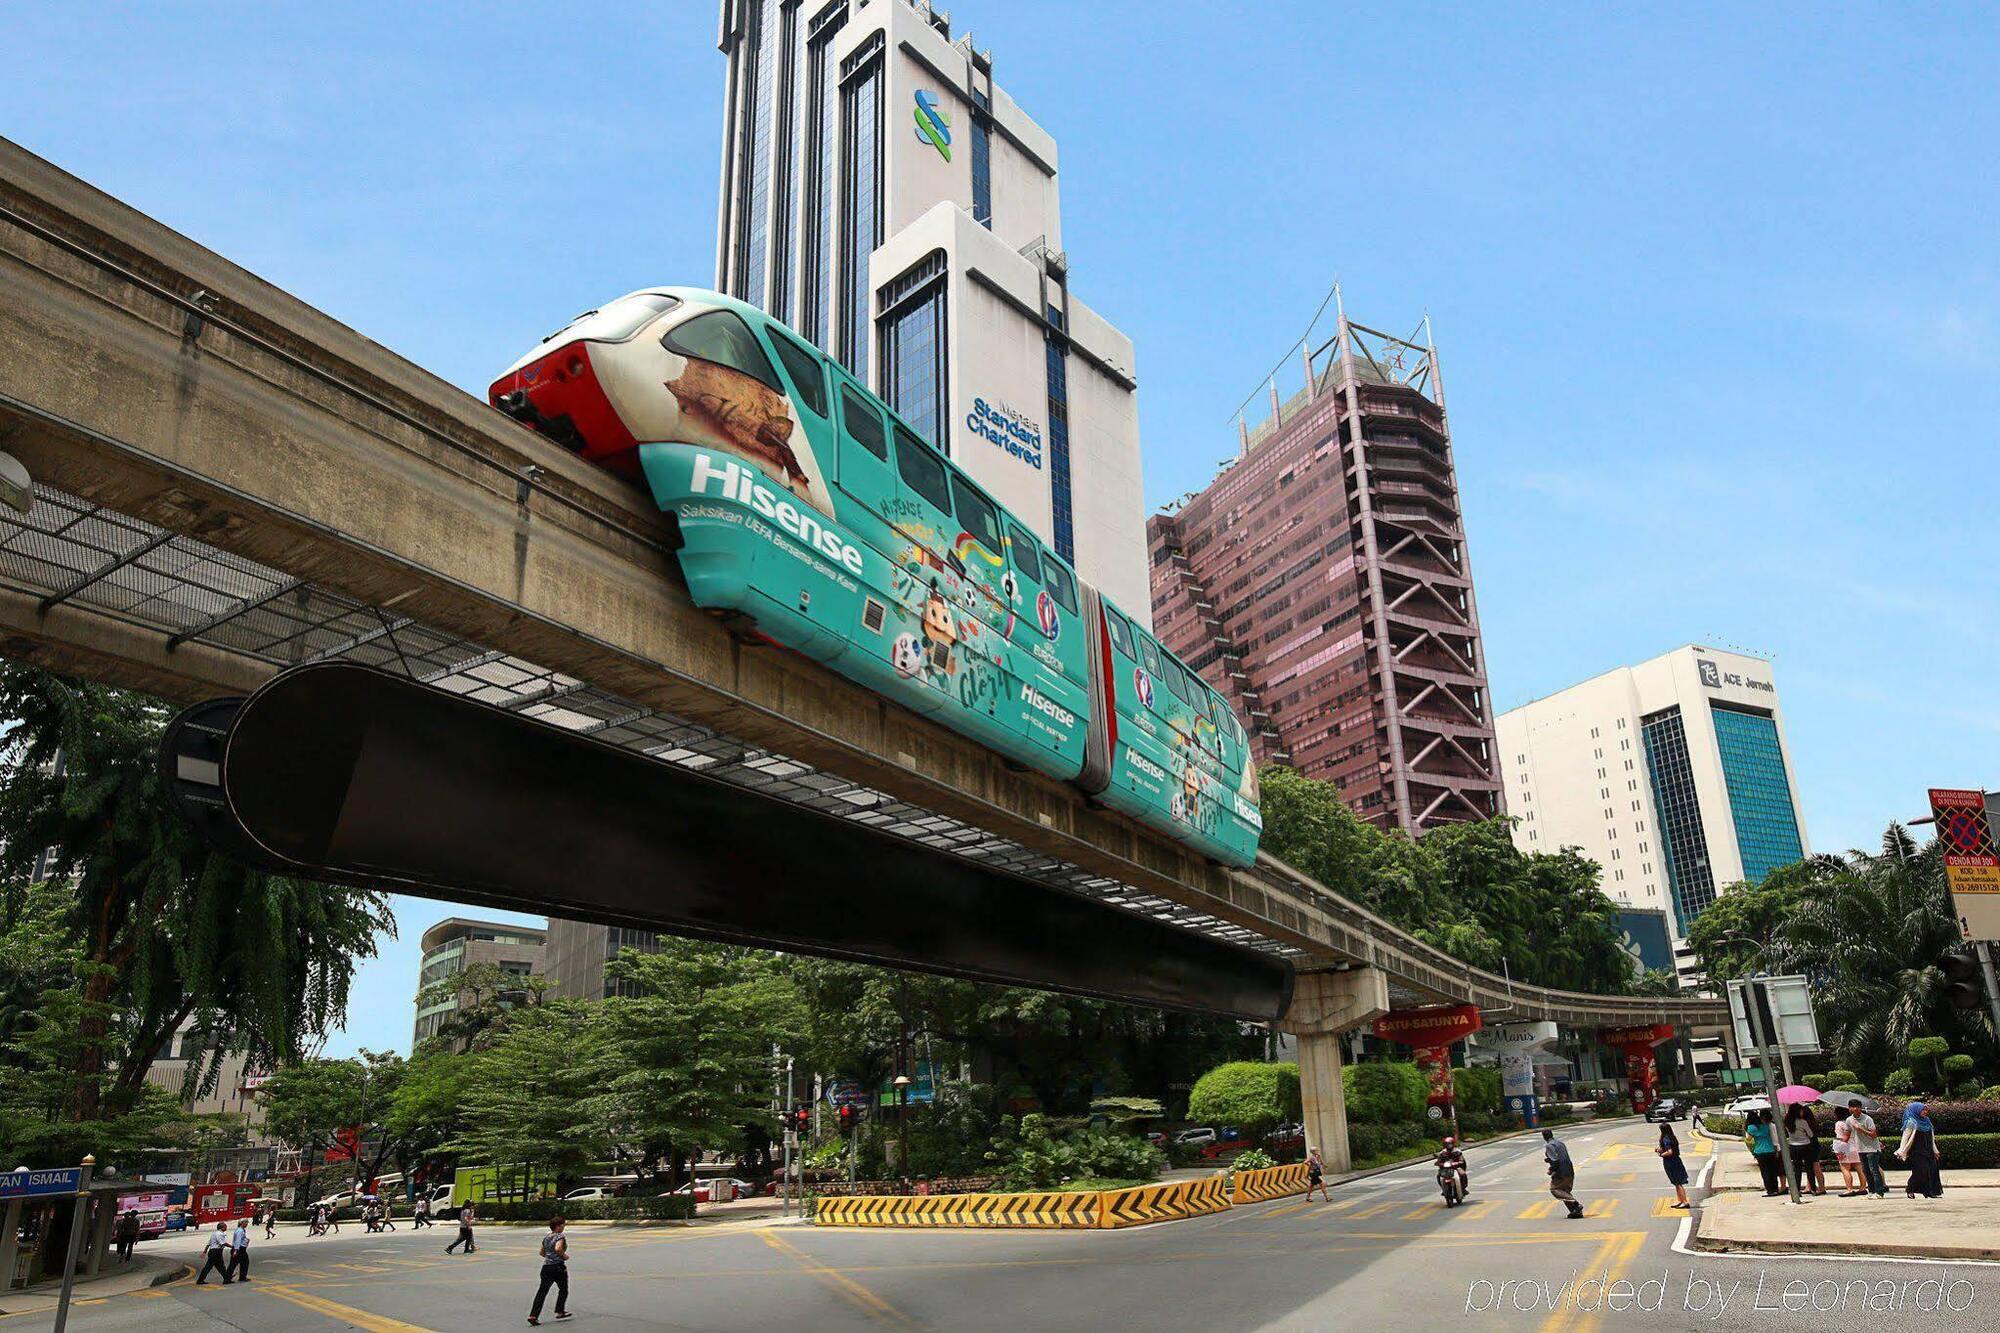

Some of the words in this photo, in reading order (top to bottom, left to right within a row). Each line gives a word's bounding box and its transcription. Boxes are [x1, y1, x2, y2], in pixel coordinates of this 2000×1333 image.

[966, 413, 1041, 470] Chartered
[974, 397, 1041, 450] Standard
[680, 503, 743, 525] Saksikan
[745, 515, 773, 541] UEFA
[690, 453, 864, 576] Hisense
[1723, 672, 1742, 687] ACE
[1021, 683, 1074, 729] Hisense
[1125, 745, 1165, 782] Hisense
[1949, 856, 1971, 866] DENDA
[1379, 1014, 1470, 1032] SATU-SATUNYA
[1489, 1029, 1536, 1045] Manis
[28, 1172, 72, 1186] ISMAIL
